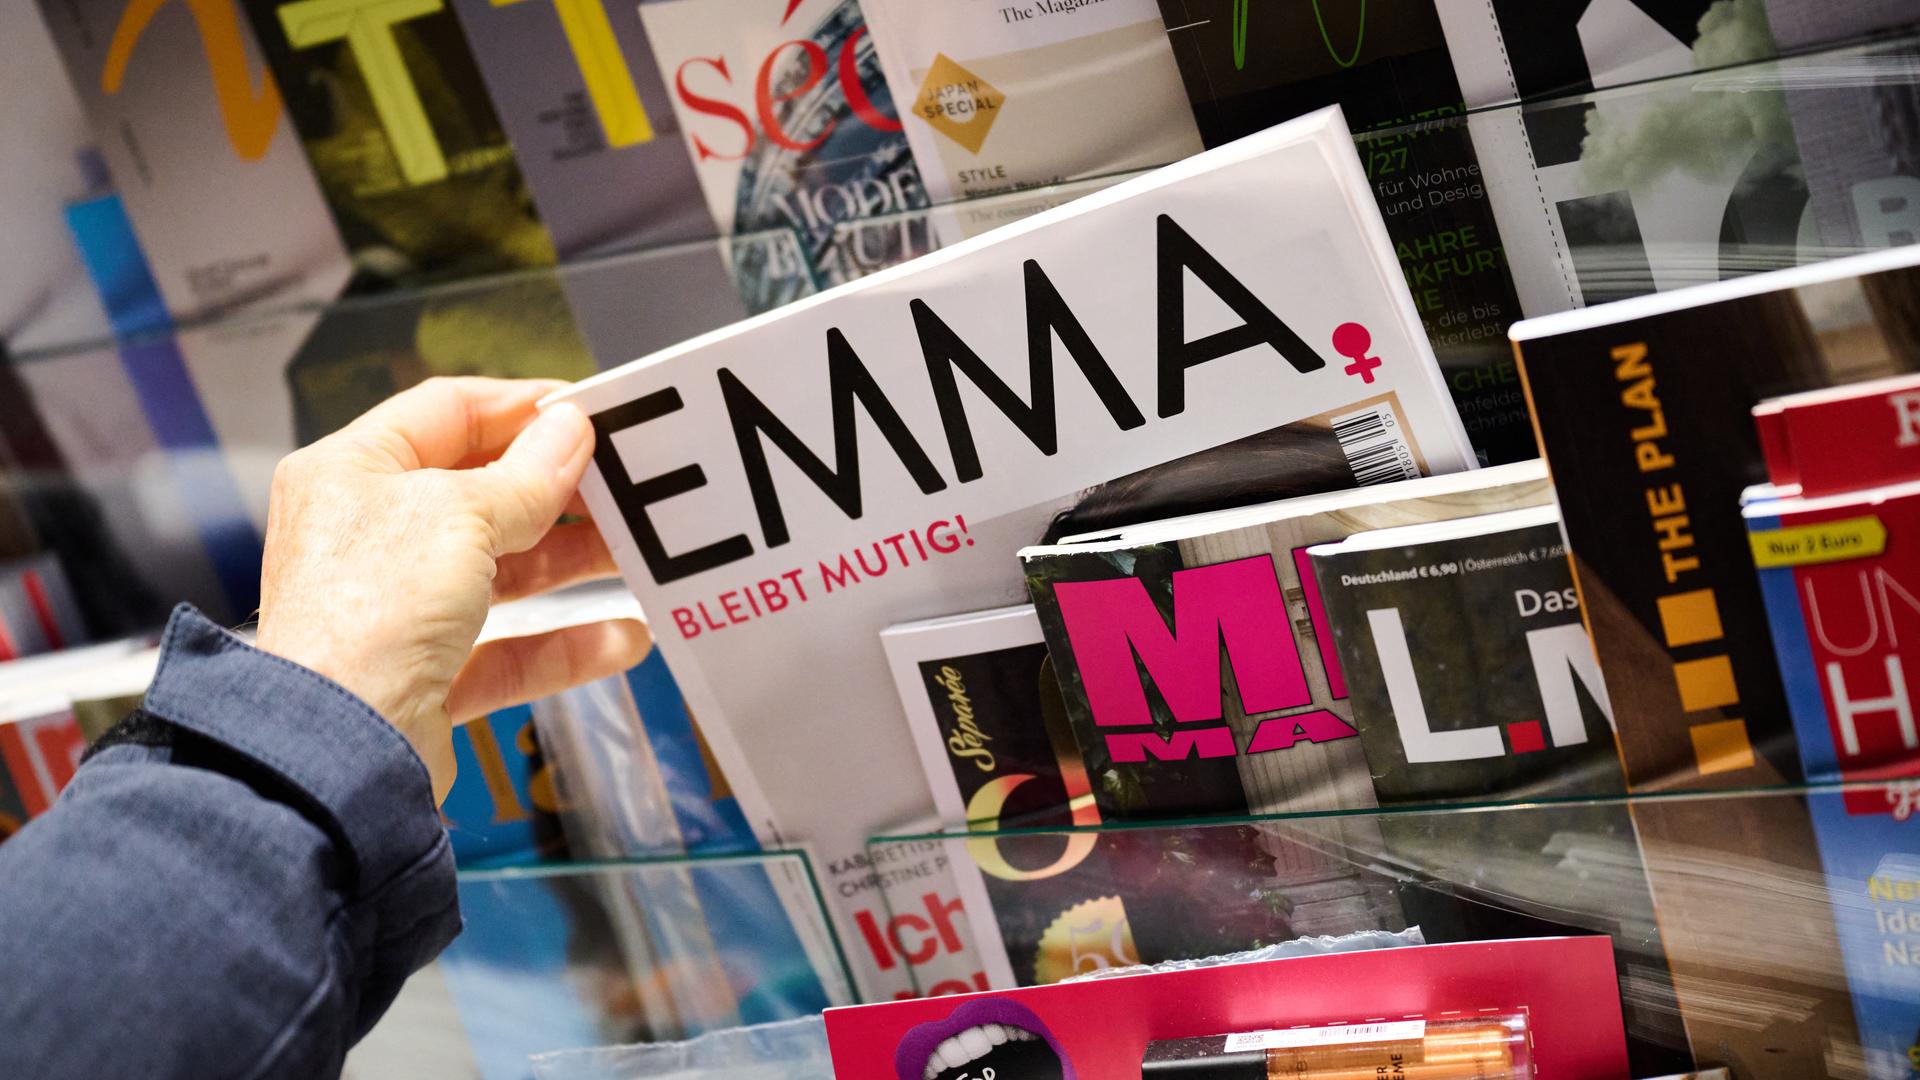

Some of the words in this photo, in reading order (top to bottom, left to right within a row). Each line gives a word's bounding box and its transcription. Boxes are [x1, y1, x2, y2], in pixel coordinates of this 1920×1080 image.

[998, 7, 1033, 23] The
[927, 79, 980, 101] JAPAN
[924, 97, 996, 119] SPECIAL
[958, 165, 1007, 183] STYLE
[1378, 182, 1405, 198] für
[1409, 163, 1480, 190] Wohne
[1386, 193, 1424, 216] und
[1428, 182, 1484, 207] Desig
[590, 212, 1326, 586] EMMA
[1610, 341, 1676, 473] PLAN
[1645, 482, 1701, 583] THE
[670, 568, 808, 641] BLEIBT
[818, 513, 976, 594] MUTIG!
[1340, 565, 1418, 586] Deutschland
[1429, 559, 1458, 577] 6,90
[1514, 587, 1580, 617] Das
[1052, 548, 1351, 728] M
[934, 665, 997, 772] Séparée
[854, 891, 964, 971] Ich
